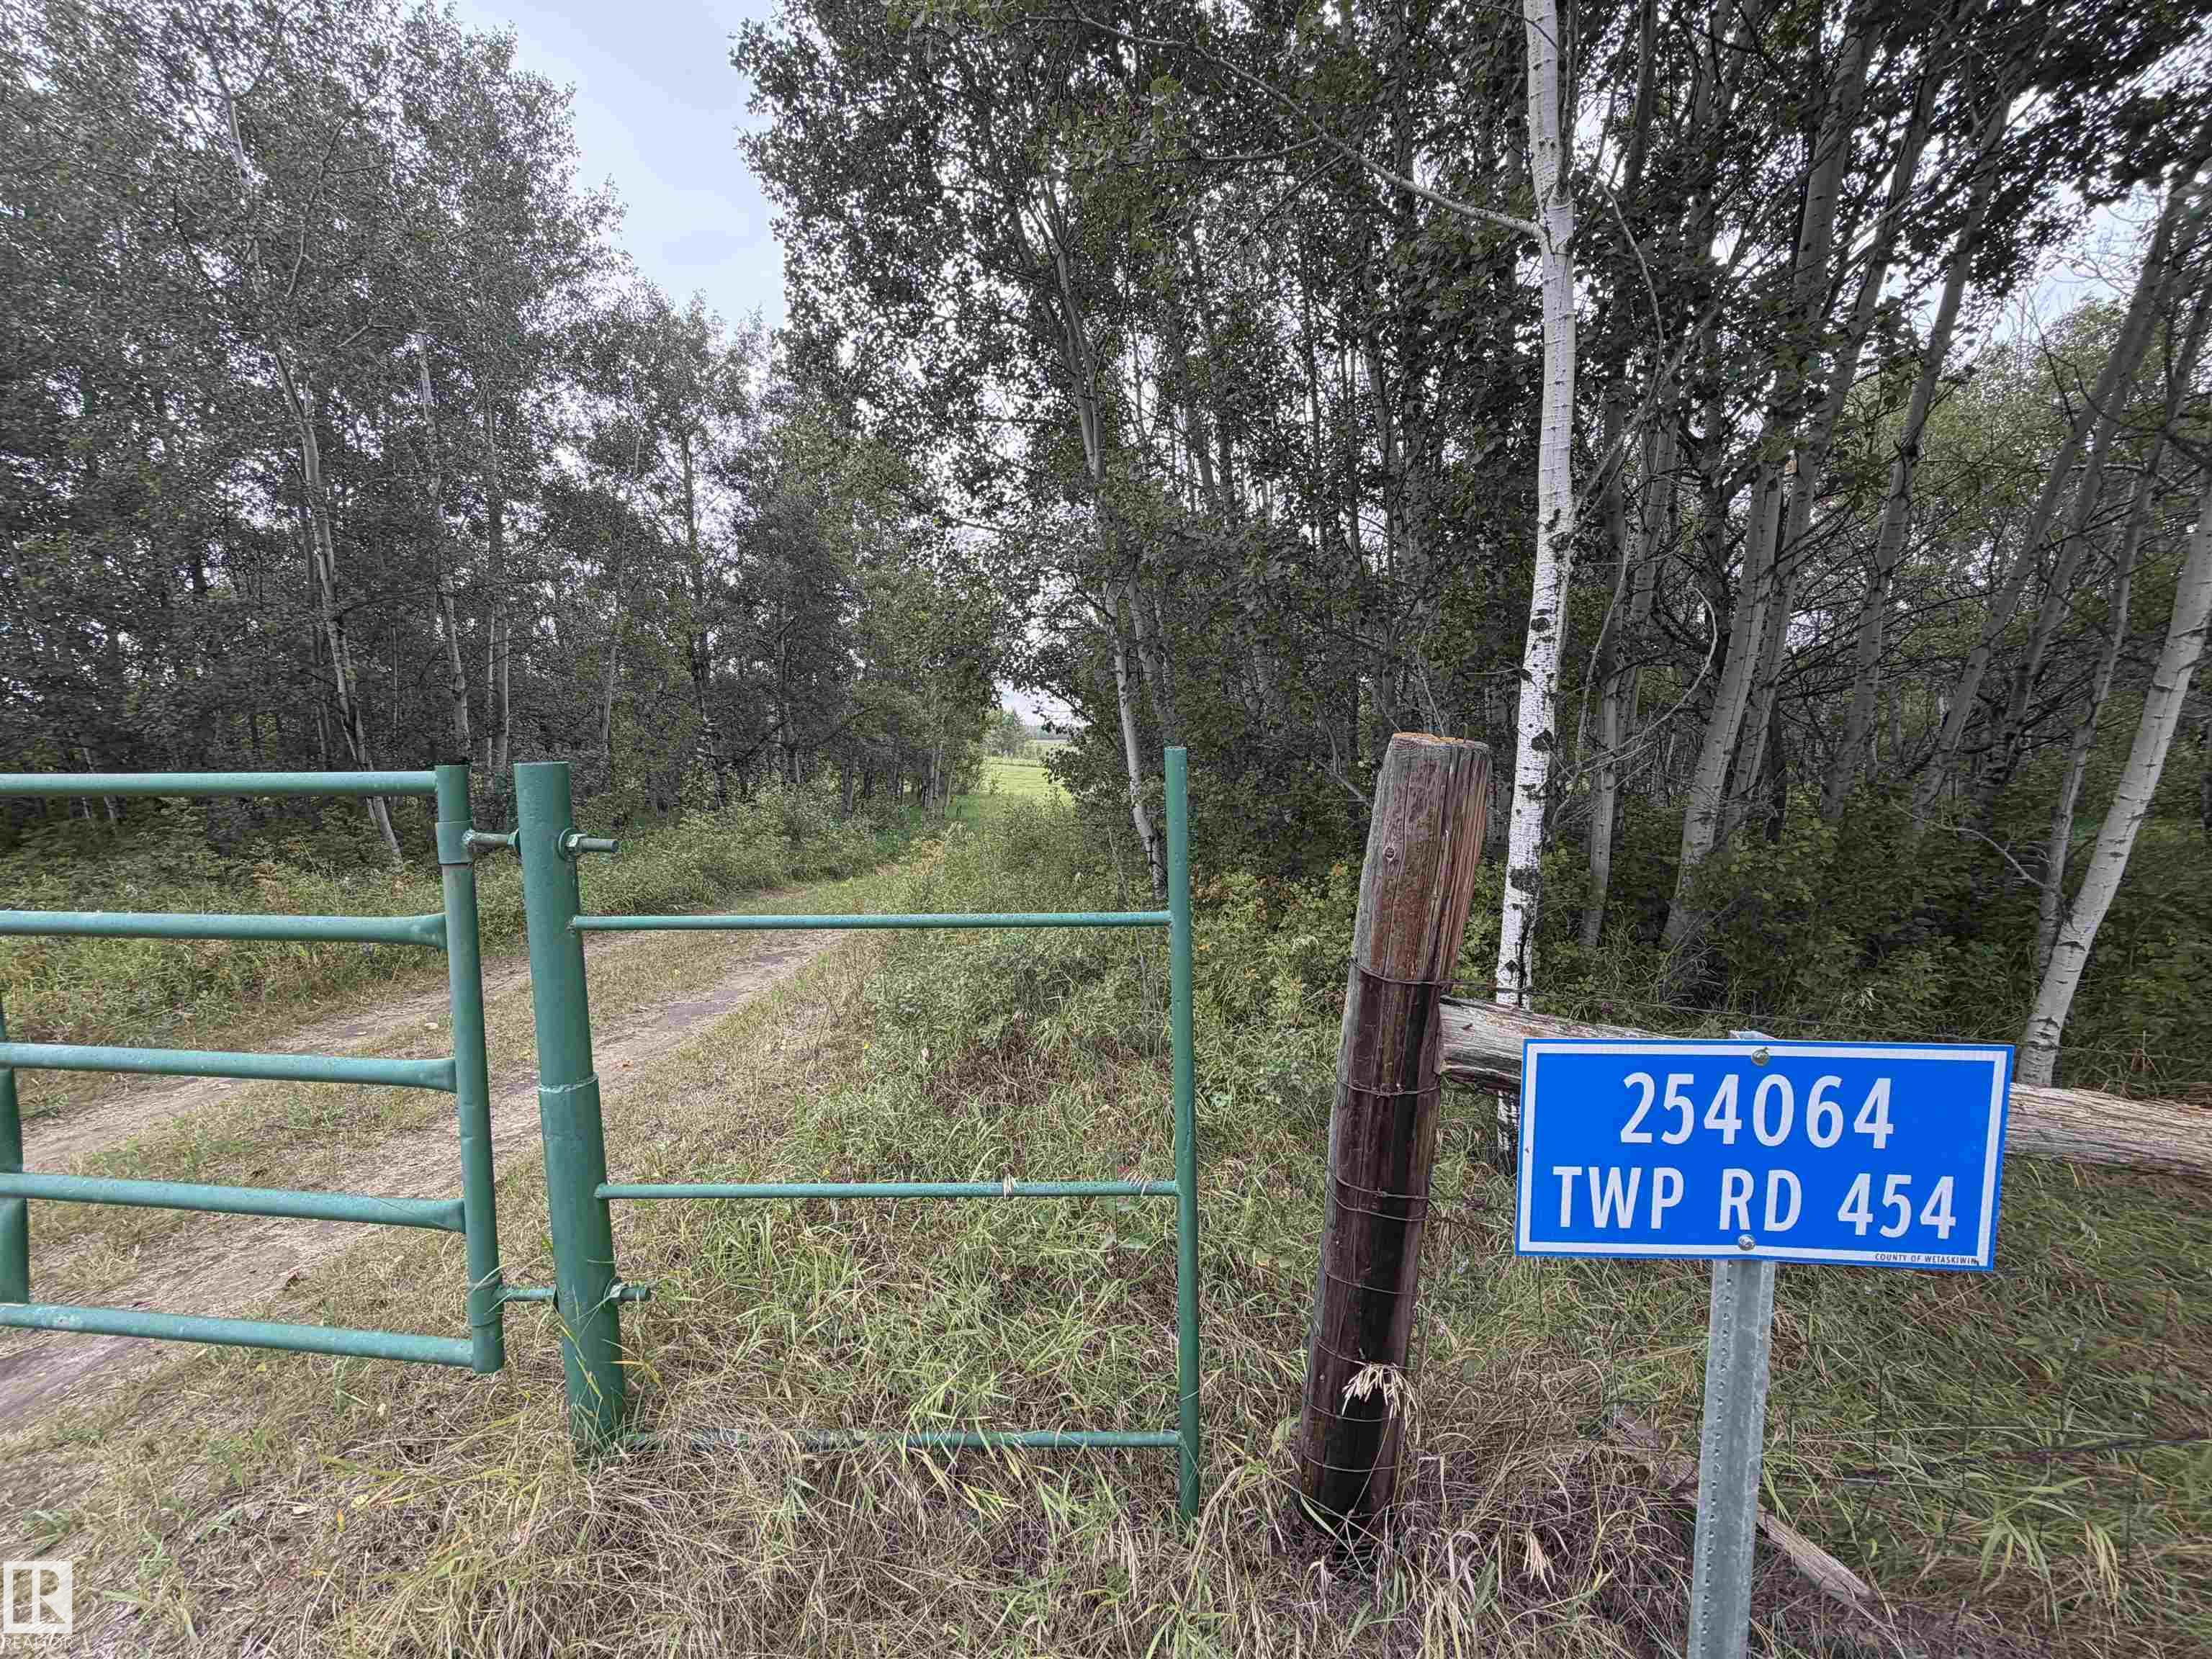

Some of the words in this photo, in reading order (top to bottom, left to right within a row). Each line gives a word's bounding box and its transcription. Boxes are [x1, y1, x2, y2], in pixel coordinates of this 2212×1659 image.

[1619, 1071, 1894, 1149] 254064
[1552, 1166, 1683, 1229] TWP
[1719, 1168, 1802, 1232] RD
[1837, 1172, 1956, 1239] 454
[1875, 1253, 1907, 1262] COUNTY
[1924, 1256, 1978, 1266] WETASKIWIN
